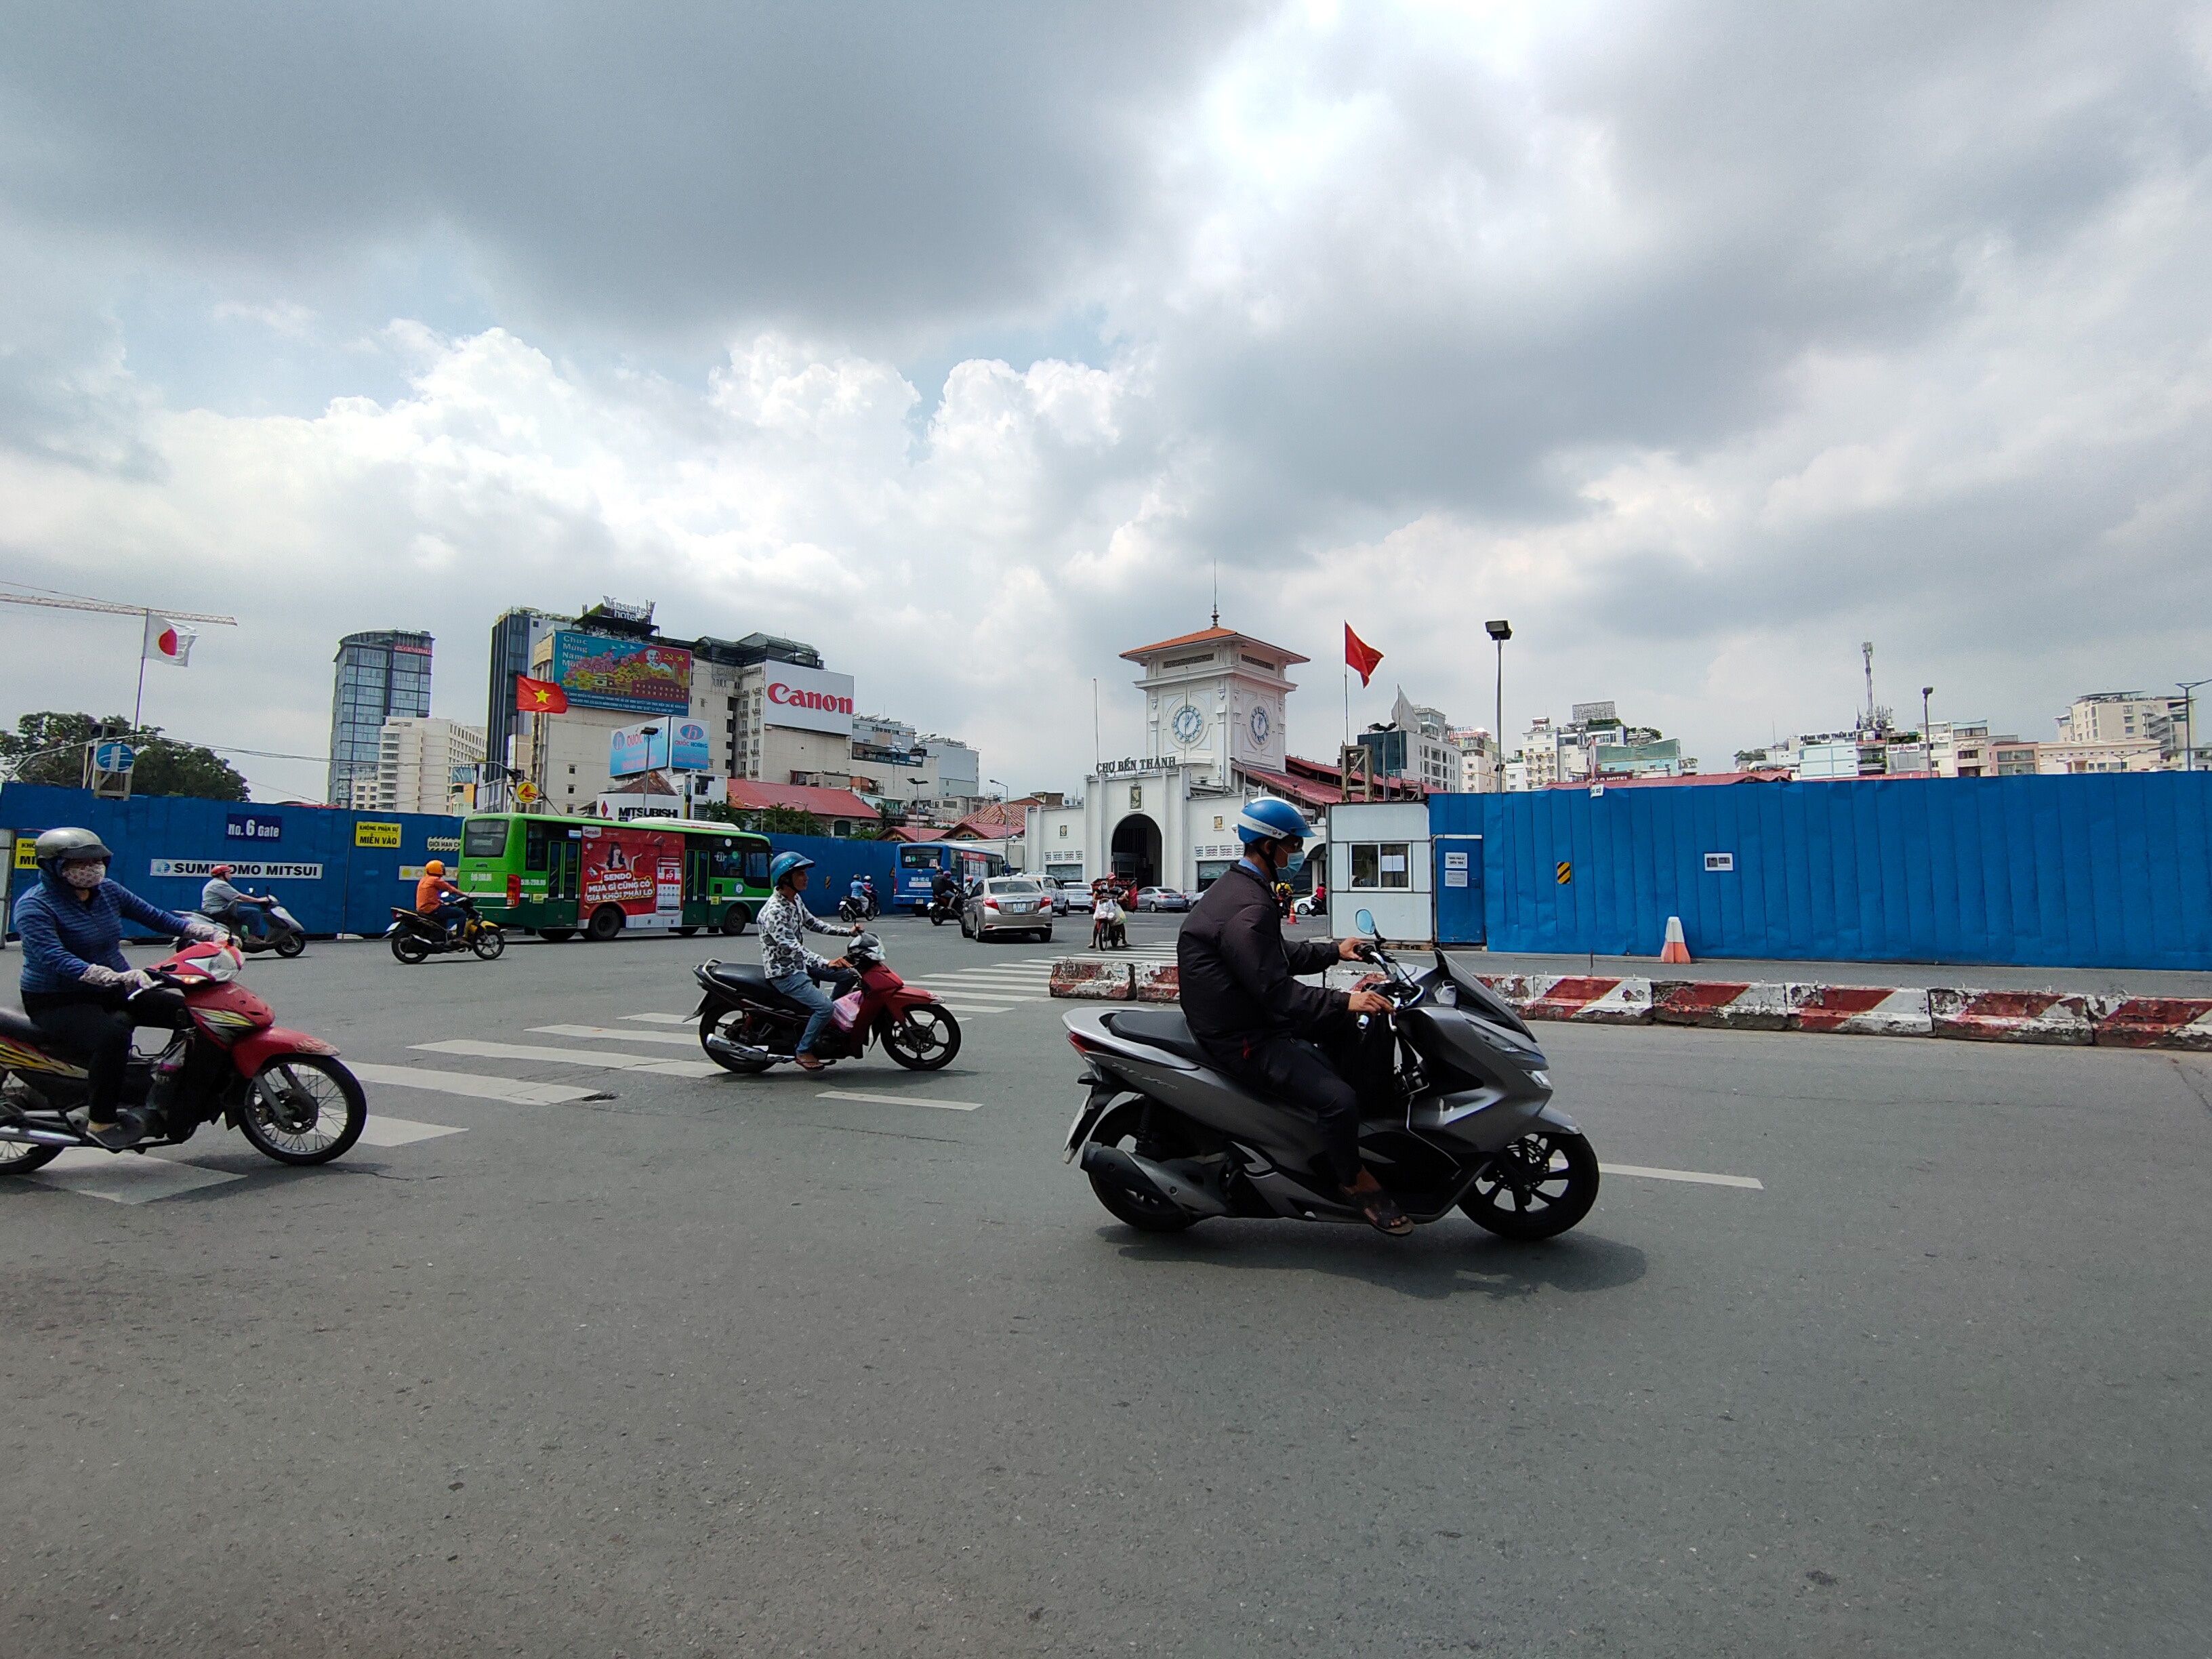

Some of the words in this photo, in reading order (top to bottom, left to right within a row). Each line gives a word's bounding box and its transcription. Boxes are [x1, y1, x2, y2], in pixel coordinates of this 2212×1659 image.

[614, 610, 638, 622] hotel
[768, 682, 853, 714] Canon
[1096, 760, 1115, 773] CHỢ
[1118, 757, 1137, 771] BẾN
[1140, 756, 1176, 769] THÀNH
[618, 806, 678, 817] MITSUBISHI
[228, 823, 244, 836] No.
[246, 819, 255, 836] 6
[258, 825, 279, 838] Gate
[359, 834, 380, 844] MIỄN
[382, 835, 397, 844] VÀO
[173, 863, 261, 876] SUMOMO
[266, 865, 317, 876] MITSUI
[604, 872, 632, 881] SENDO
[588, 884, 607, 893] MUA
[586, 893, 601, 901] GIÁ
